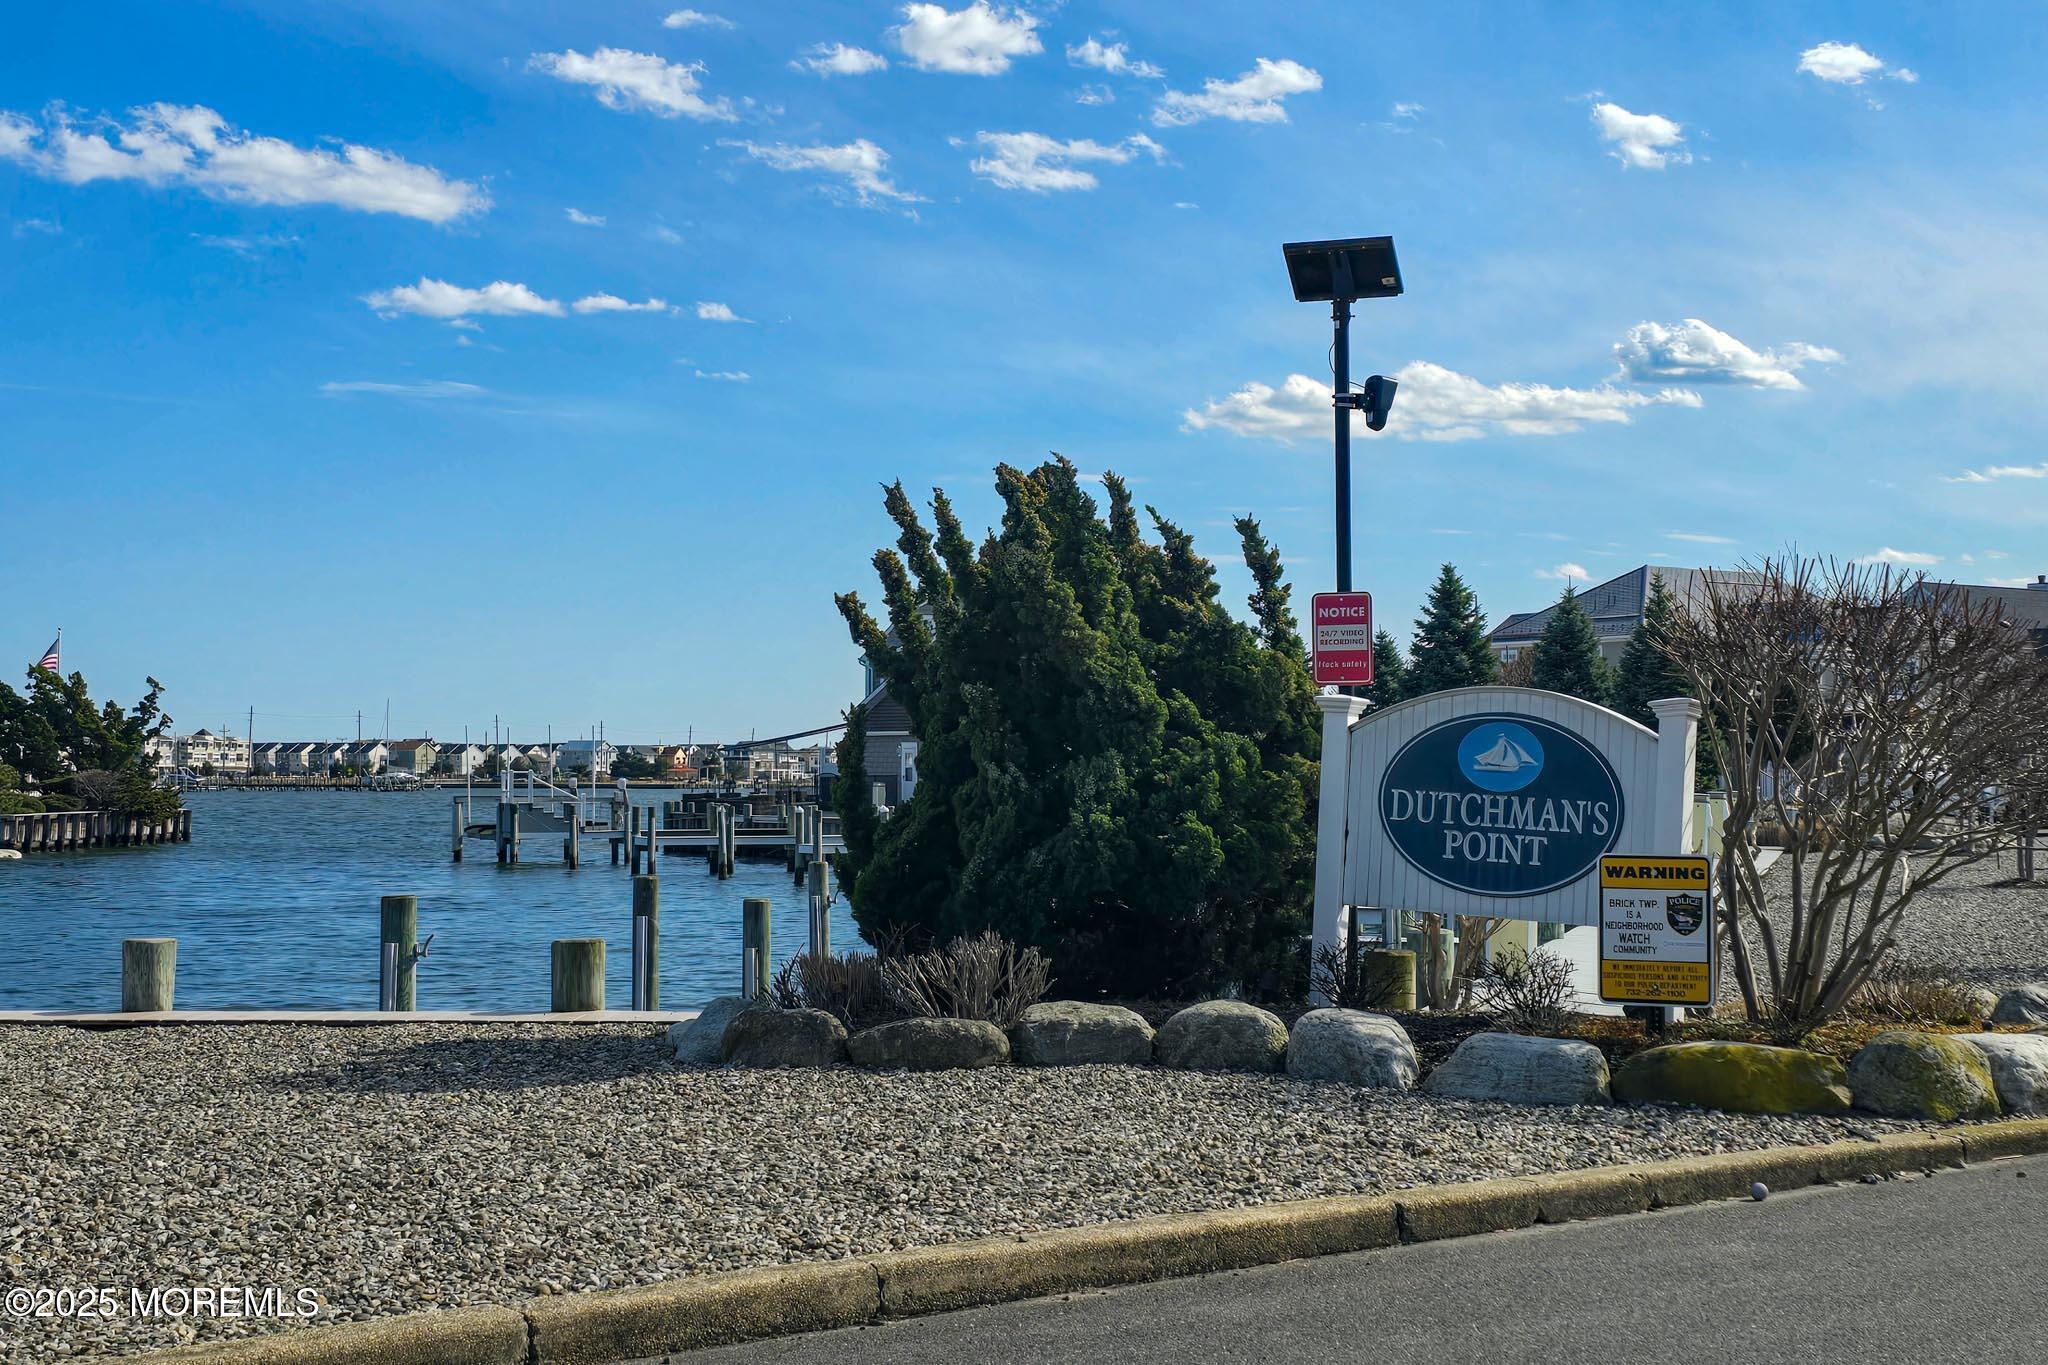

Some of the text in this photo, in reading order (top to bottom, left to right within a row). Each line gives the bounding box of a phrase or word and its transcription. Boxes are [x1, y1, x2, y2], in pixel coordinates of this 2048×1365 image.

[1320, 606, 1365, 618] NOTICE
[1389, 788, 1609, 836] DUTCHMAN'S
[1442, 829, 1548, 866] POINT
[1604, 866, 1705, 880] WARNING
[1609, 898, 1660, 909] BRICK TWP.
[1670, 897, 1699, 906] POLICE
[1604, 921, 1664, 931] NEIGHBORHOOD
[1619, 933, 1650, 944] WATCH
[1613, 945, 1657, 954] COMMUNITY
